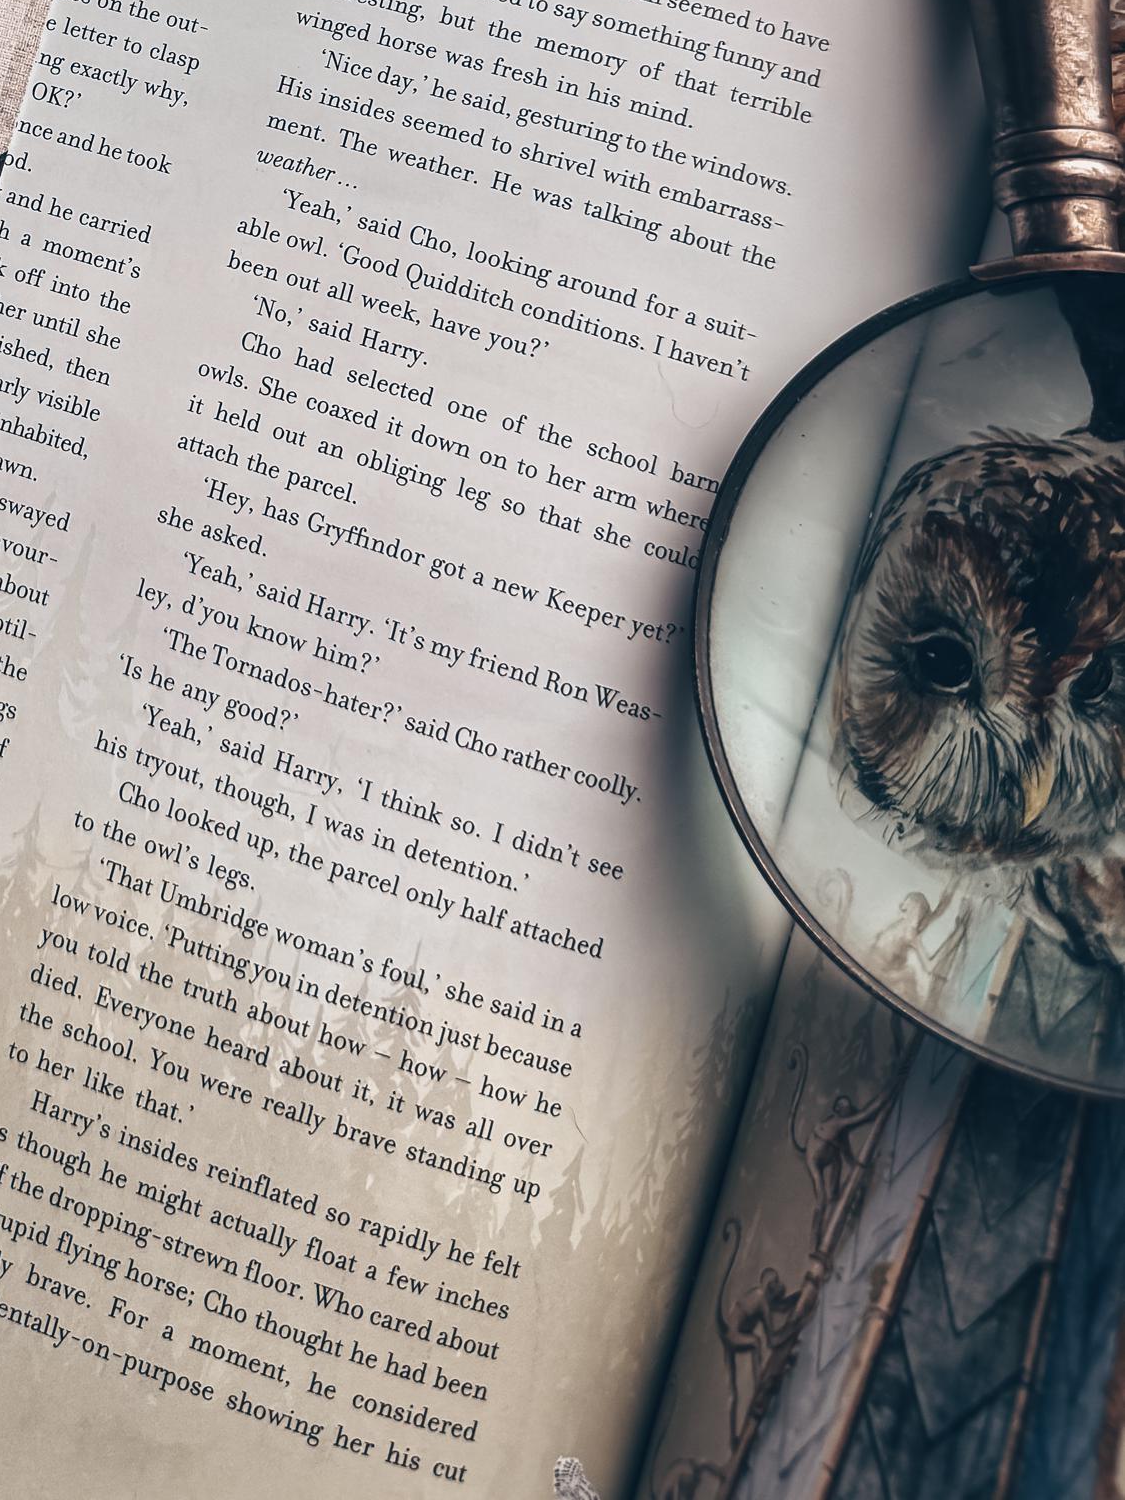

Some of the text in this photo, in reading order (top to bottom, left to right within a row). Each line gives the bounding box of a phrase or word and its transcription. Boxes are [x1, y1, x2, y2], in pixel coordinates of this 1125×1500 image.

[437, 4, 476, 33] but
[487, 18, 523, 45] the
[533, 35, 629, 77] memory
[638, 61, 666, 82] of
[674, 68, 719, 98] that
[729, 86, 813, 125] terrible
[552, 3, 590, 29] say
[591, 13, 712, 63] something
[712, 39, 779, 81] funny
[779, 65, 822, 89] and
[275, 73, 785, 230] His insides seemed to shrivel with embarrass-
[65, 355, 111, 387] then
[156, 504, 267, 558] she asked.
[176, 435, 358, 506] attach the parcel.
[73, 809, 95, 833] to
[102, 818, 137, 848] the
[205, 852, 256, 892] legs.
[93, 728, 129, 760] his
[135, 746, 205, 791] tryout,
[214, 773, 296, 823] though,
[304, 803, 319, 827] I
[323, 815, 365, 843] was
[371, 826, 396, 854] in
[118, 780, 605, 960] Cho looked up, the parcel only half attached
[19, 1001, 542, 1205] the school. You were really brave standing up
[16, 1129, 92, 1177] though
[98, 1158, 129, 1190] he
[134, 1179, 204, 1219] might
[209, 1209, 299, 1259] actually
[303, 1235, 359, 1275] float
[364, 1264, 378, 1282] a
[385, 1264, 430, 1296] few
[434, 1285, 511, 1321] inches
[24, 1261, 92, 1310] brave.
[107, 1295, 150, 1331] For
[160, 1324, 175, 1343] a
[188, 1333, 291, 1389] moment,
[306, 1370, 338, 1401] he
[351, 1393, 480, 1443] considered
[225, 1390, 326, 1449] showing
[332, 1423, 376, 1458] her
[384, 1440, 422, 1472] his
[431, 1461, 468, 1484] cut
